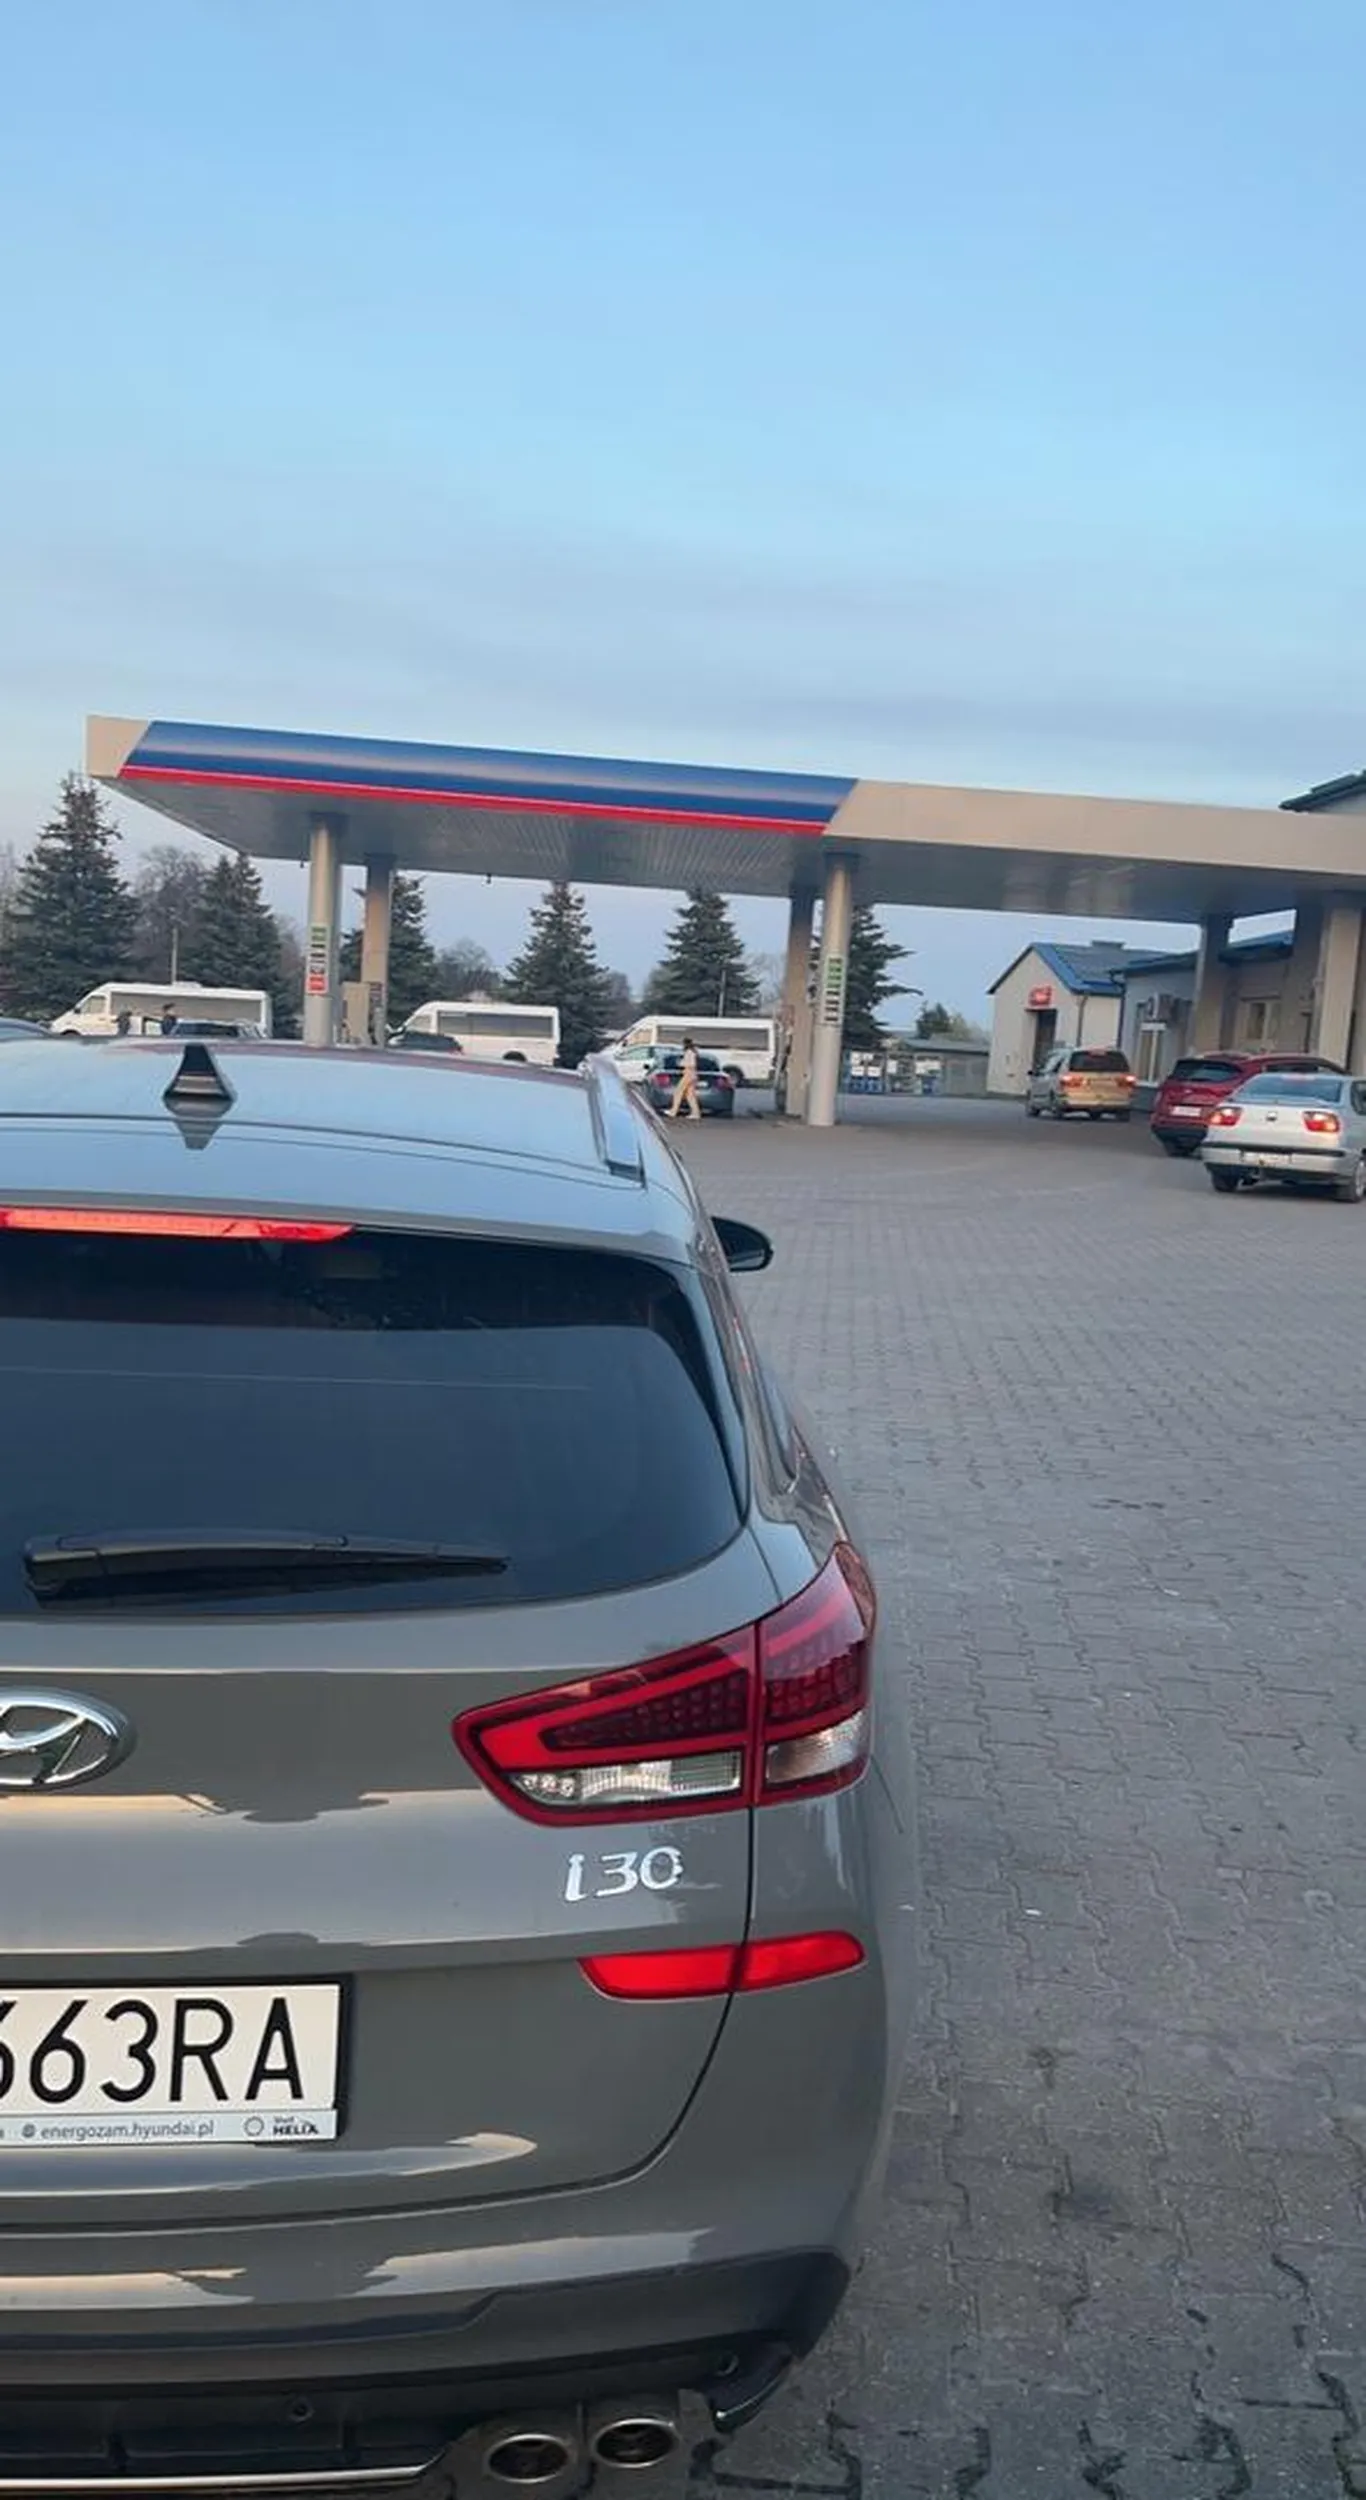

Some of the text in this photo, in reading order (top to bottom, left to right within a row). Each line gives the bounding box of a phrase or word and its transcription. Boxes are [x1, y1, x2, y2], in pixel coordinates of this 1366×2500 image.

[565, 1846, 684, 1902] i30
[0, 1997, 304, 2104] 63RA
[40, 2120, 214, 2140] energozam.hyundai.pl
